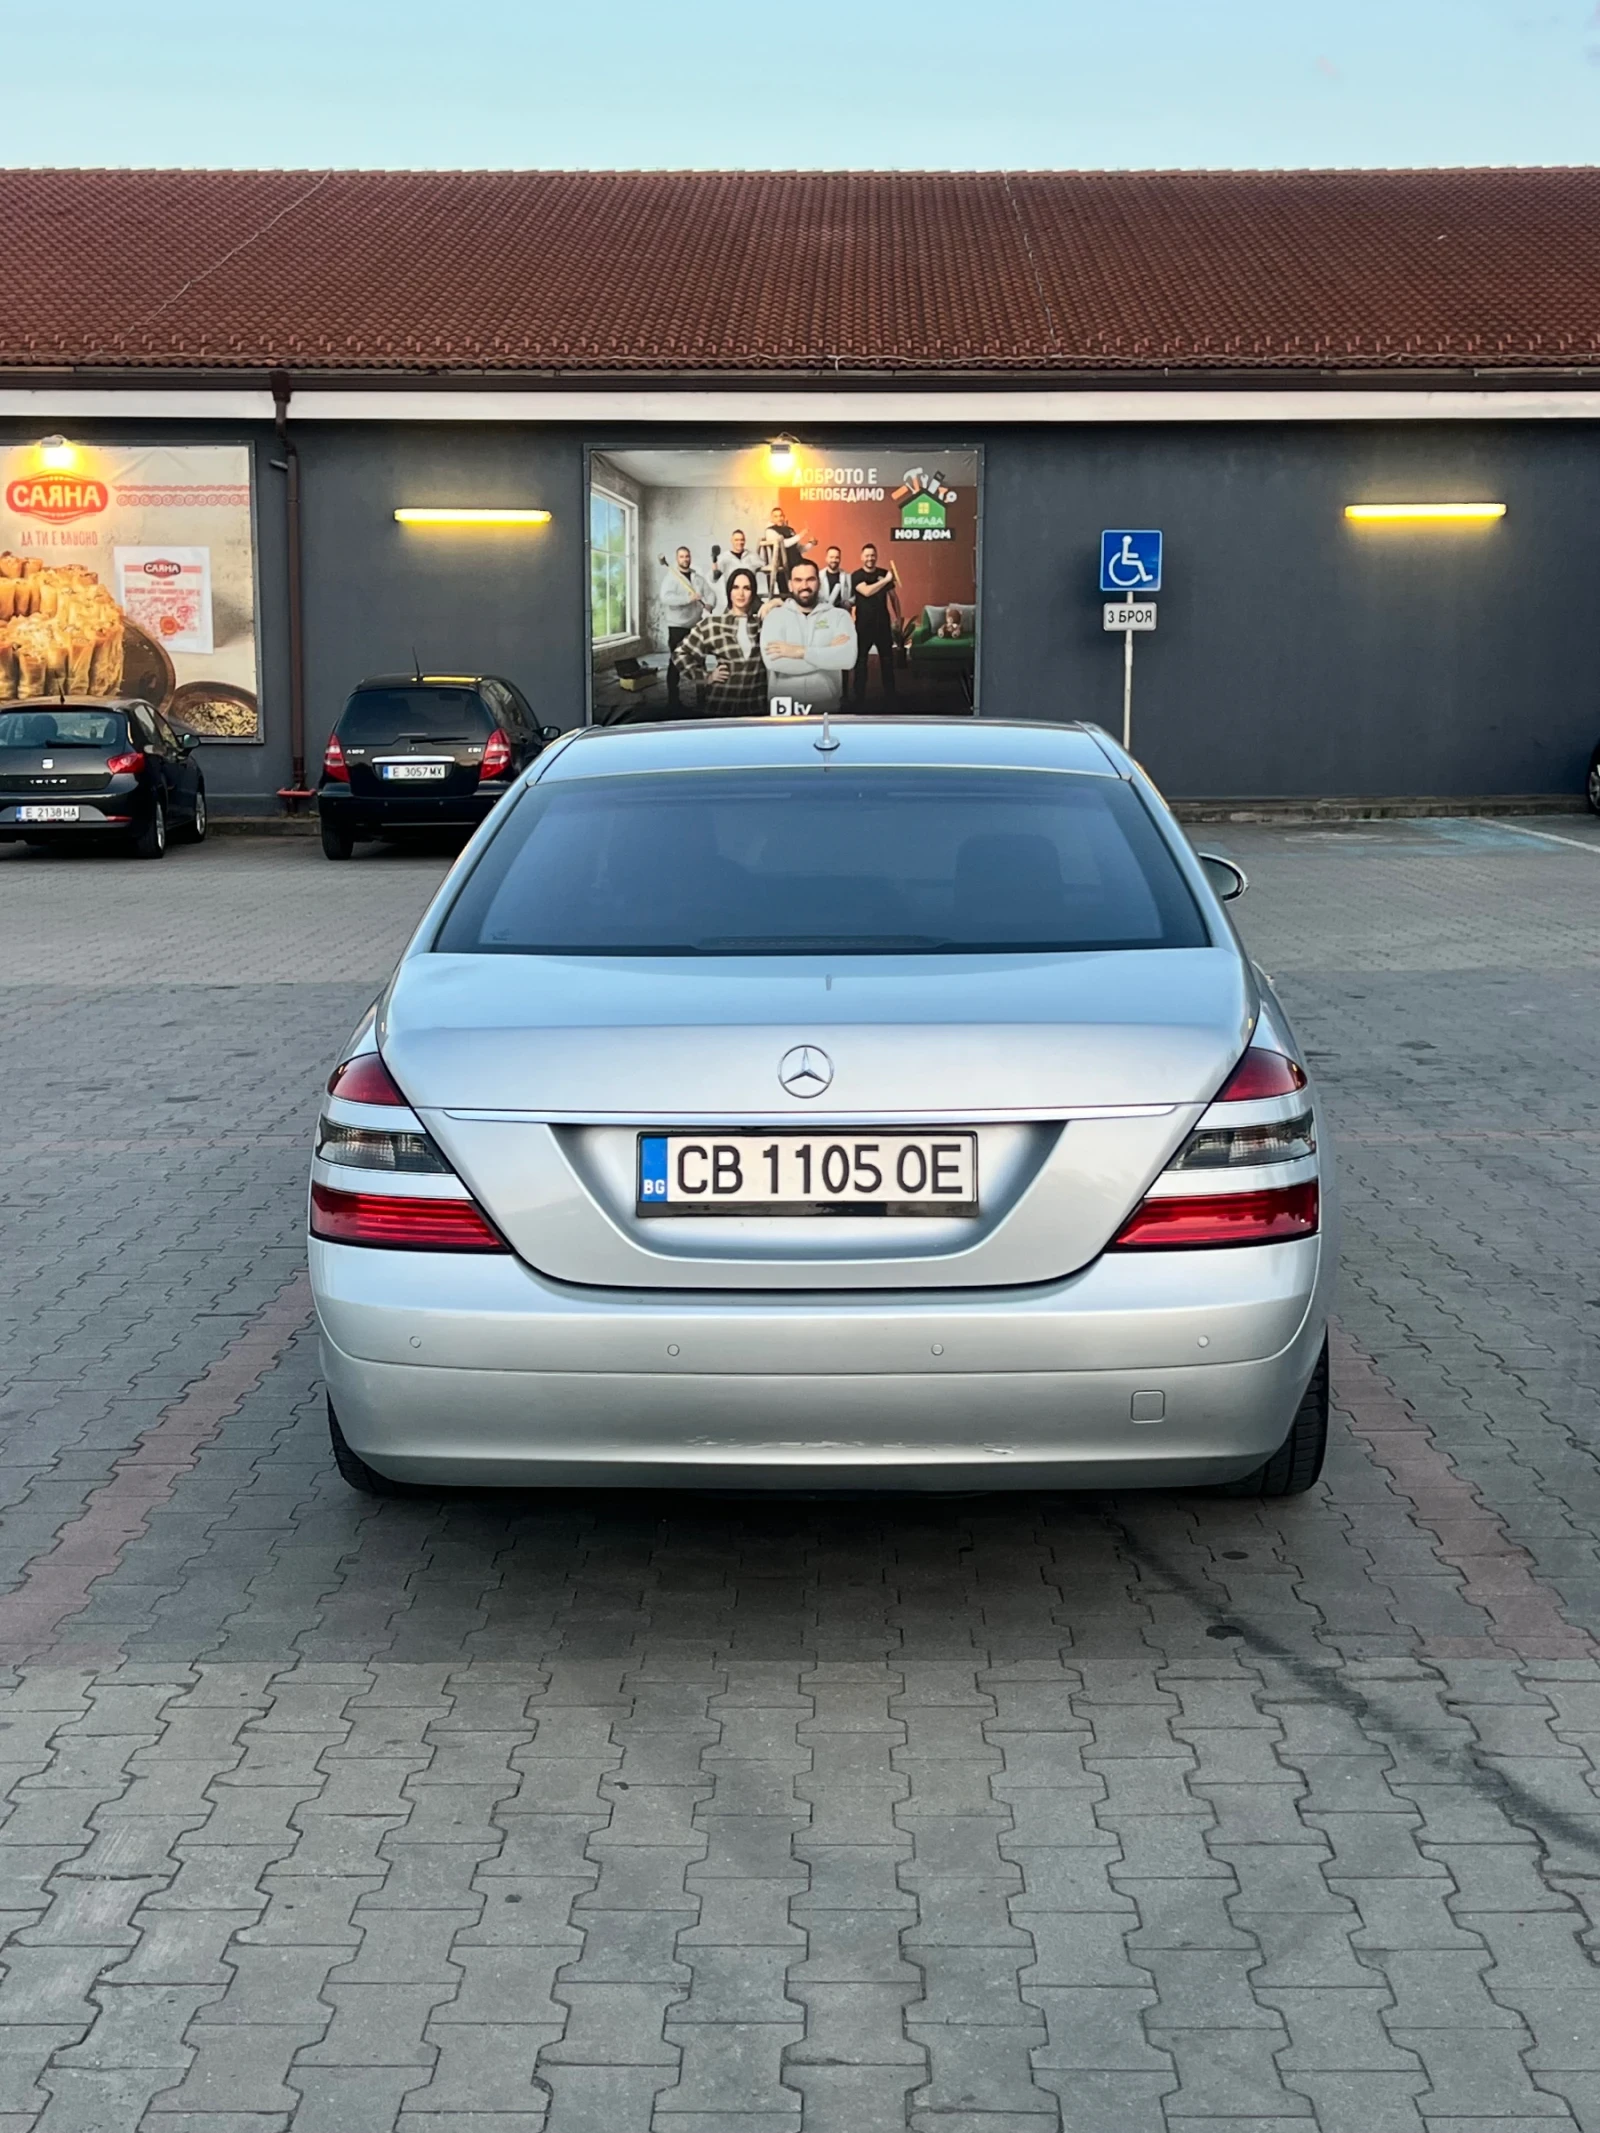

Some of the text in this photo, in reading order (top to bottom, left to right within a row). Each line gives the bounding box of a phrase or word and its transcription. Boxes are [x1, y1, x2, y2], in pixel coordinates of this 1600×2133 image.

[792, 467, 878, 486] ДОБРОТО Е
[12, 484, 102, 508] САЯНА
[799, 487, 885, 503] НЕПОБЕДИМО
[903, 516, 944, 526] БРИГАДА
[895, 529, 952, 541] НОВ ДОМ
[145, 563, 180, 573] САЯНА
[1107, 610, 1153, 623] 3 БРОЯ
[392, 767, 400, 777] E
[404, 766, 427, 777] 3057
[25, 807, 77, 818] E 2138 HA
[677, 1144, 963, 1194] CB 1105 OE
[643, 1179, 665, 1195] BG
